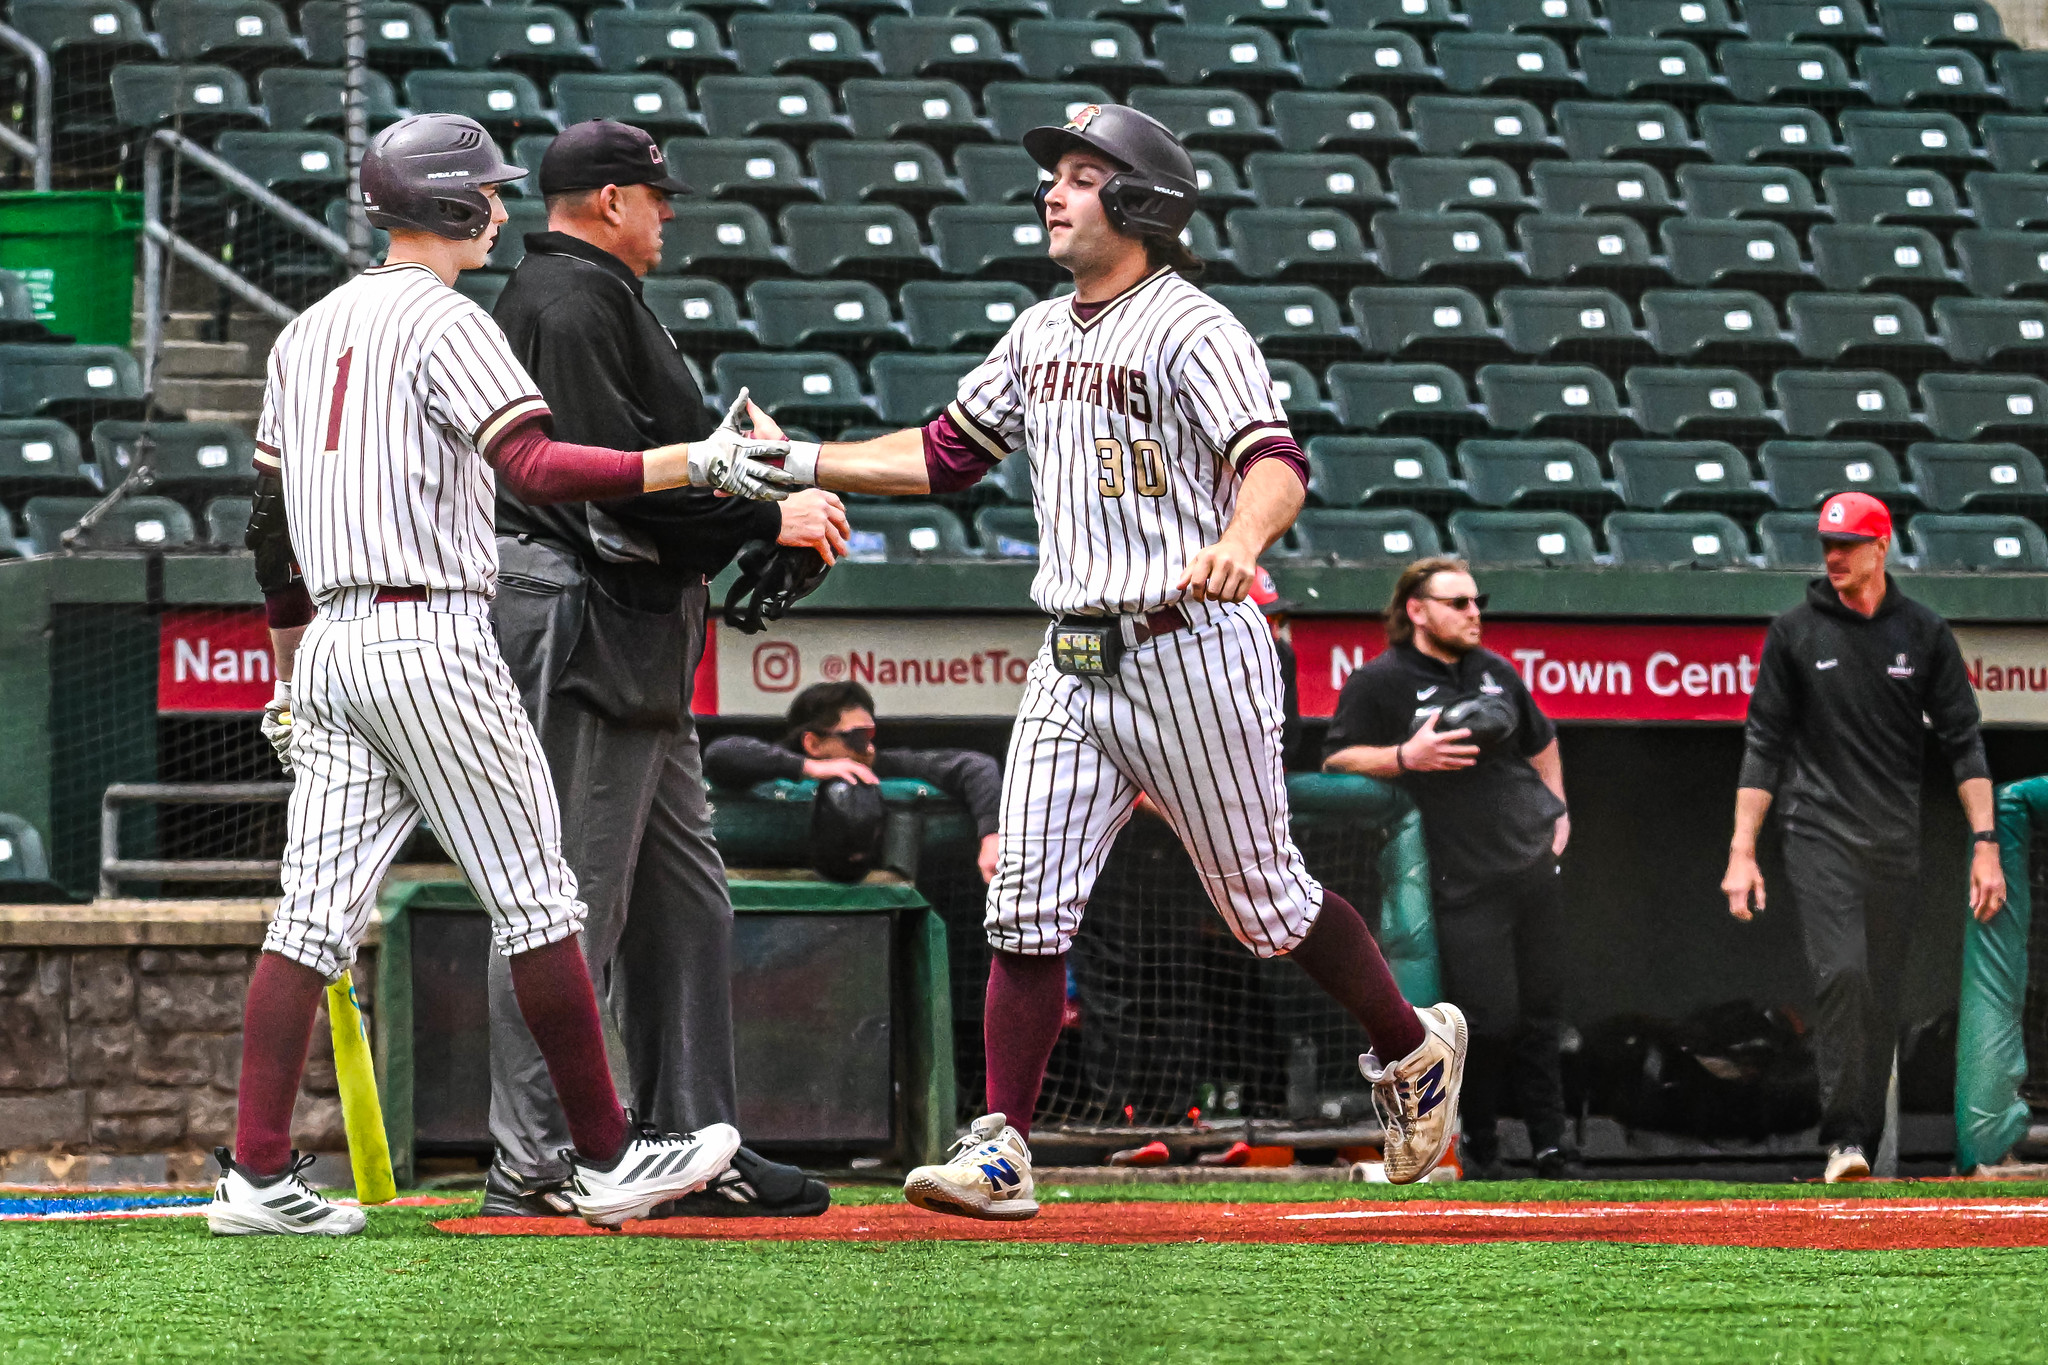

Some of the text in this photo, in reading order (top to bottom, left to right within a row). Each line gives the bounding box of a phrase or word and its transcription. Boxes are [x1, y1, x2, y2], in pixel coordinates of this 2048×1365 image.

[323, 345, 354, 455] 1
[1094, 437, 1168, 497] 30
[174, 637, 279, 683] Nan
[819, 649, 1037, 686] @NanuetTo
[1512, 648, 1632, 696] Town
[1645, 651, 1760, 697] Cent
